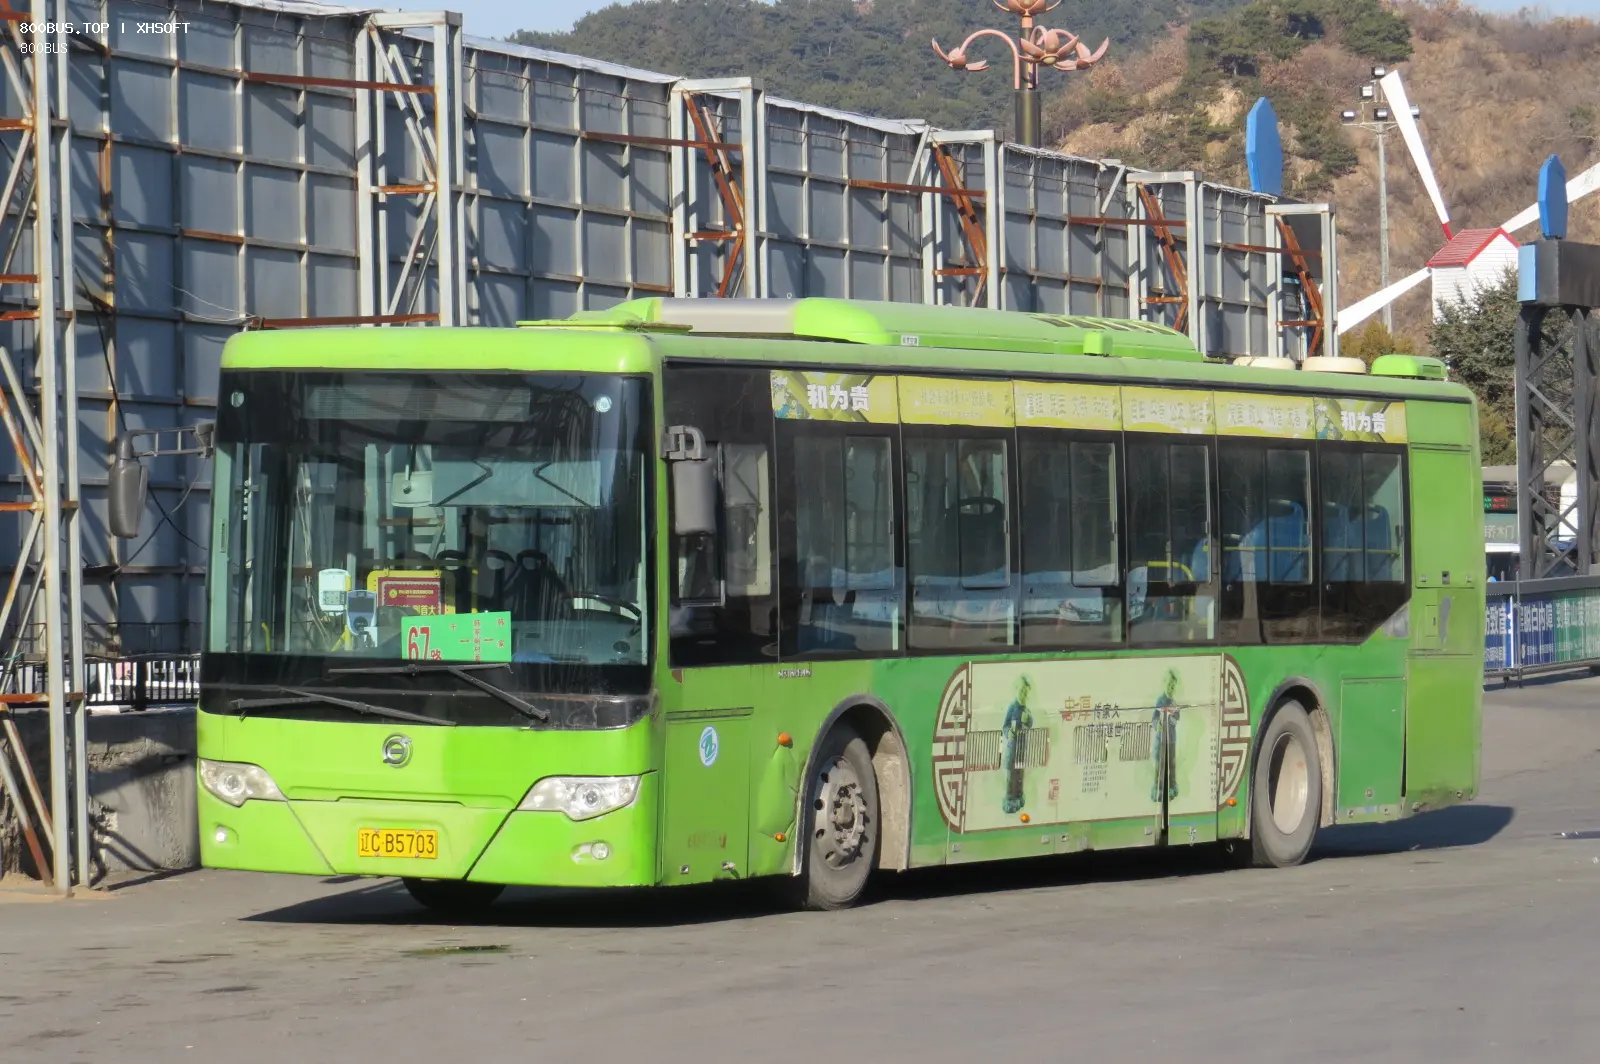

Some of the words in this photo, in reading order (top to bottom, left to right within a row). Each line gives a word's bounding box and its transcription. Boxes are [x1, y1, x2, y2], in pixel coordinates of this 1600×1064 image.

[806, 384, 870, 412] 和为贵
[1340, 410, 1386, 433] 和为贵
